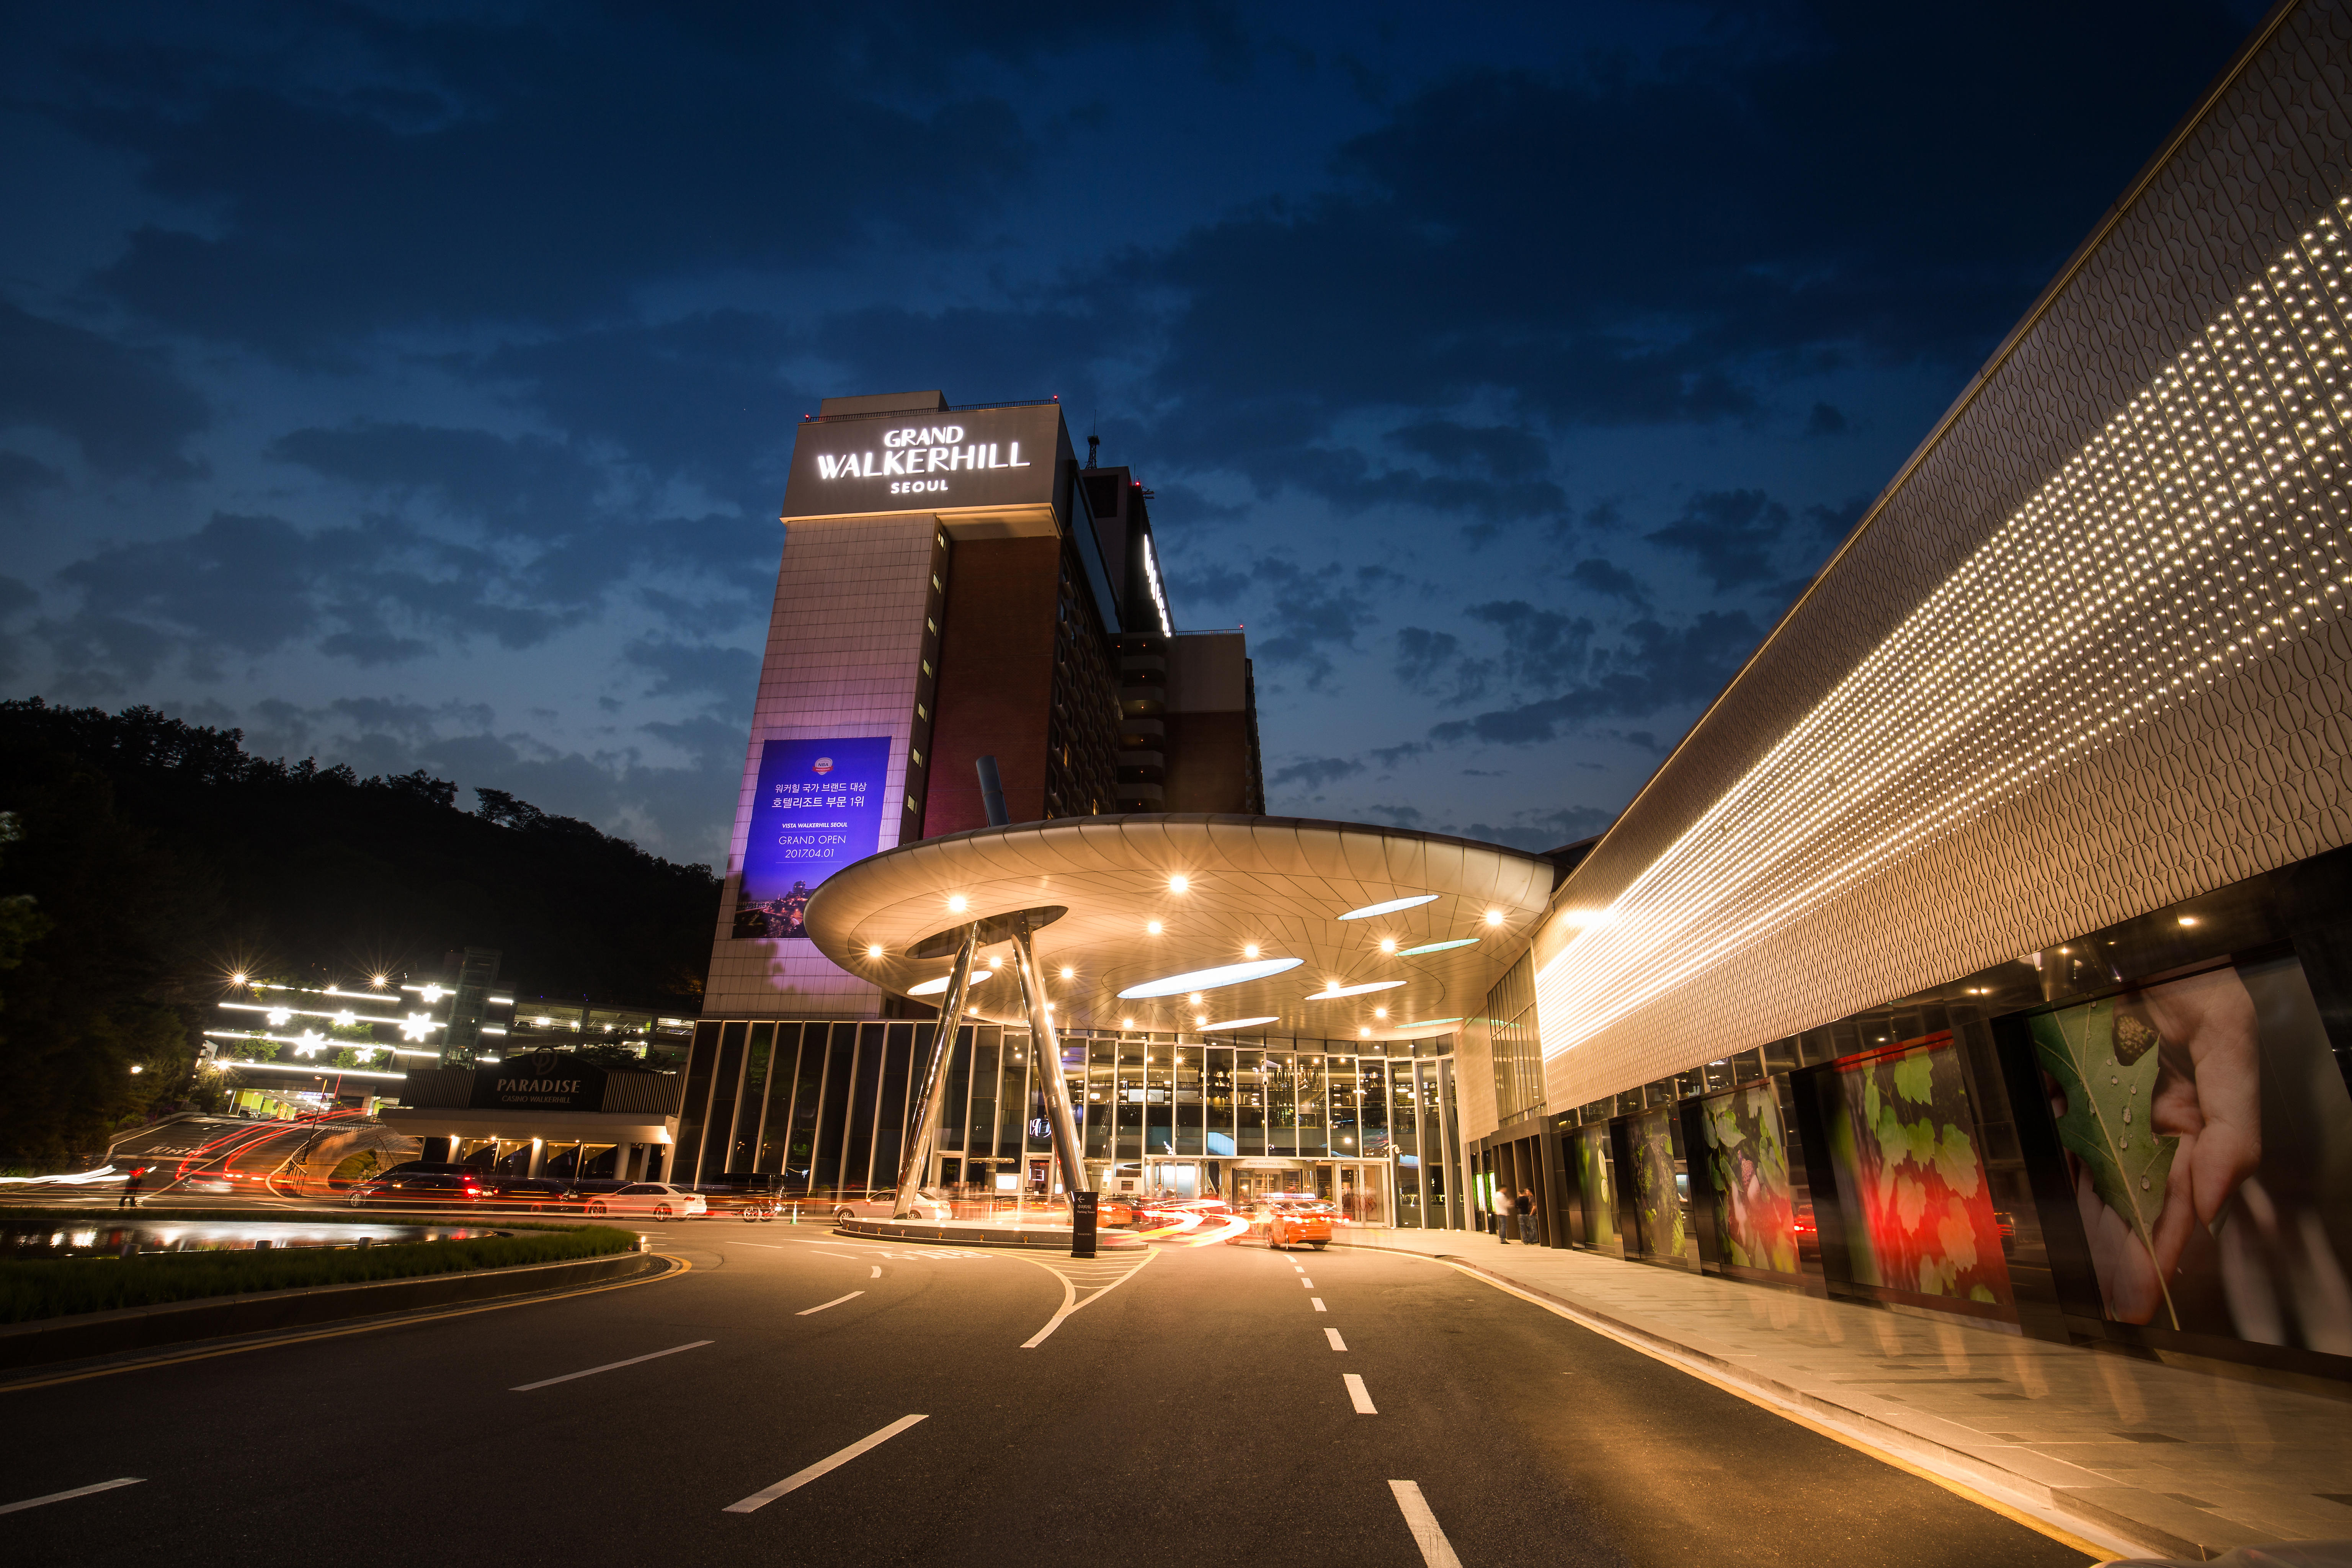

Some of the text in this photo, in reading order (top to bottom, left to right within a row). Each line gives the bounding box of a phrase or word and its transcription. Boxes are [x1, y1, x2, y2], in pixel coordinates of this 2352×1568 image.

[884, 426, 964, 448] GRAND
[818, 442, 1031, 479] WALKERHILL
[890, 479, 948, 494] SEOUL
[775, 782, 867, 793] 워커힐 국가 브랜드 대상
[772, 796, 864, 808] 호텔리조트 부문 1위
[779, 835, 846, 844] GRAND OPEN
[785, 849, 834, 858] 2017.04.01
[497, 1079, 581, 1093] PARADISE
[862, 1249, 993, 1260] 주차장
